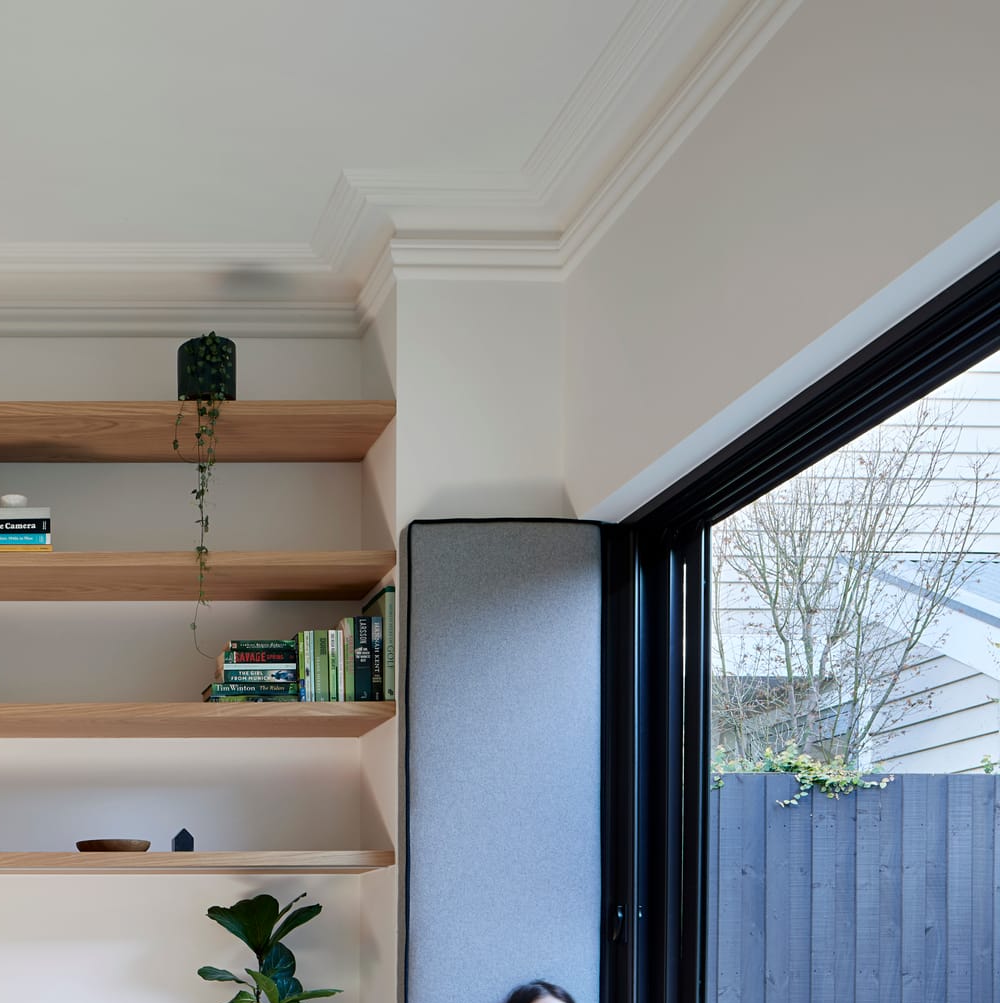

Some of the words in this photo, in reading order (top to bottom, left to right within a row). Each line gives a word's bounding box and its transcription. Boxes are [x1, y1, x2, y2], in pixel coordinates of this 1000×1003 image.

[4, 522, 36, 530] Camera
[359, 618, 368, 645] LARSSON
[319, 637, 327, 656] DUNE
[235, 651, 267, 662] SAVAGE
[216, 684, 230, 692] Tim
[229, 684, 256, 692] Winton
